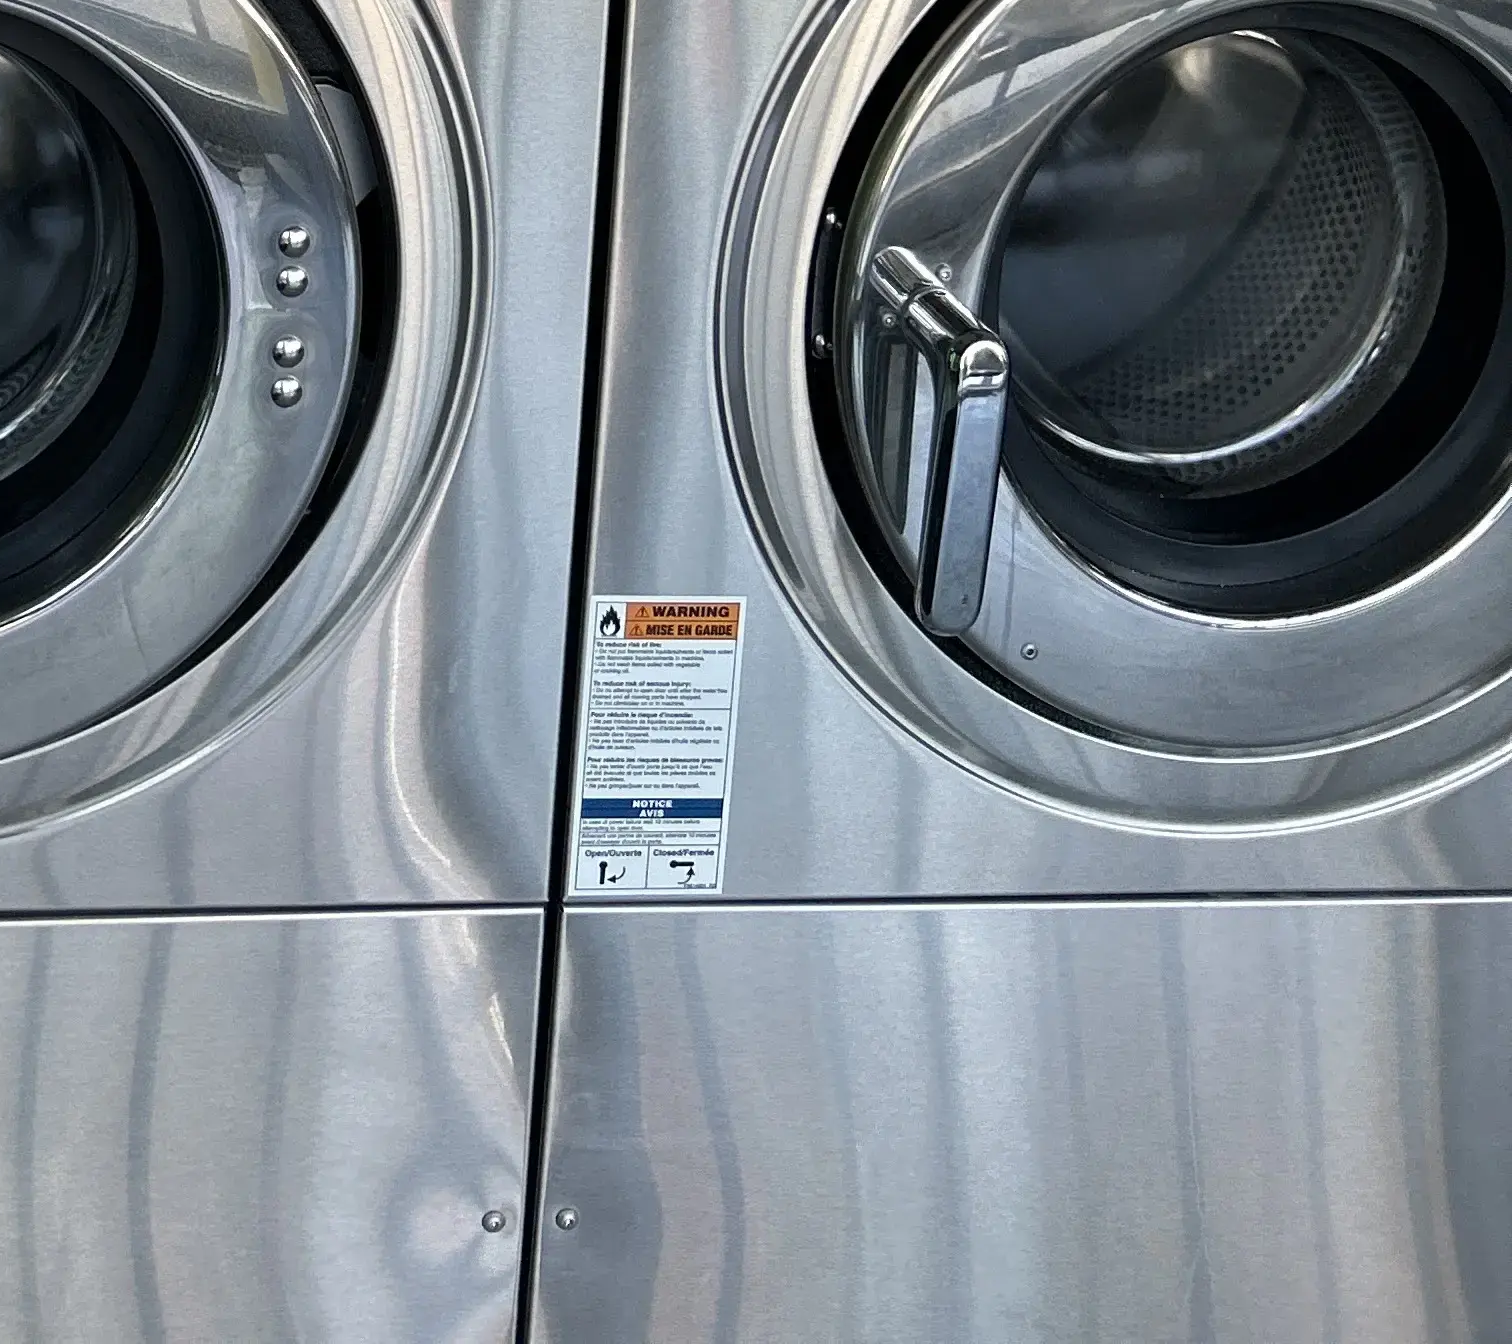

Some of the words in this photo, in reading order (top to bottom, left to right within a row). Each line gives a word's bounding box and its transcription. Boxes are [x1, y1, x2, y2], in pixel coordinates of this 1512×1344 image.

[652, 606, 730, 618] WARNING
[645, 625, 674, 636] MISE
[677, 625, 692, 635] EN
[695, 625, 733, 636] GARDE
[632, 800, 673, 808] NOTICE
[639, 809, 665, 818] AVIS
[585, 849, 642, 857] Open/Ouverte
